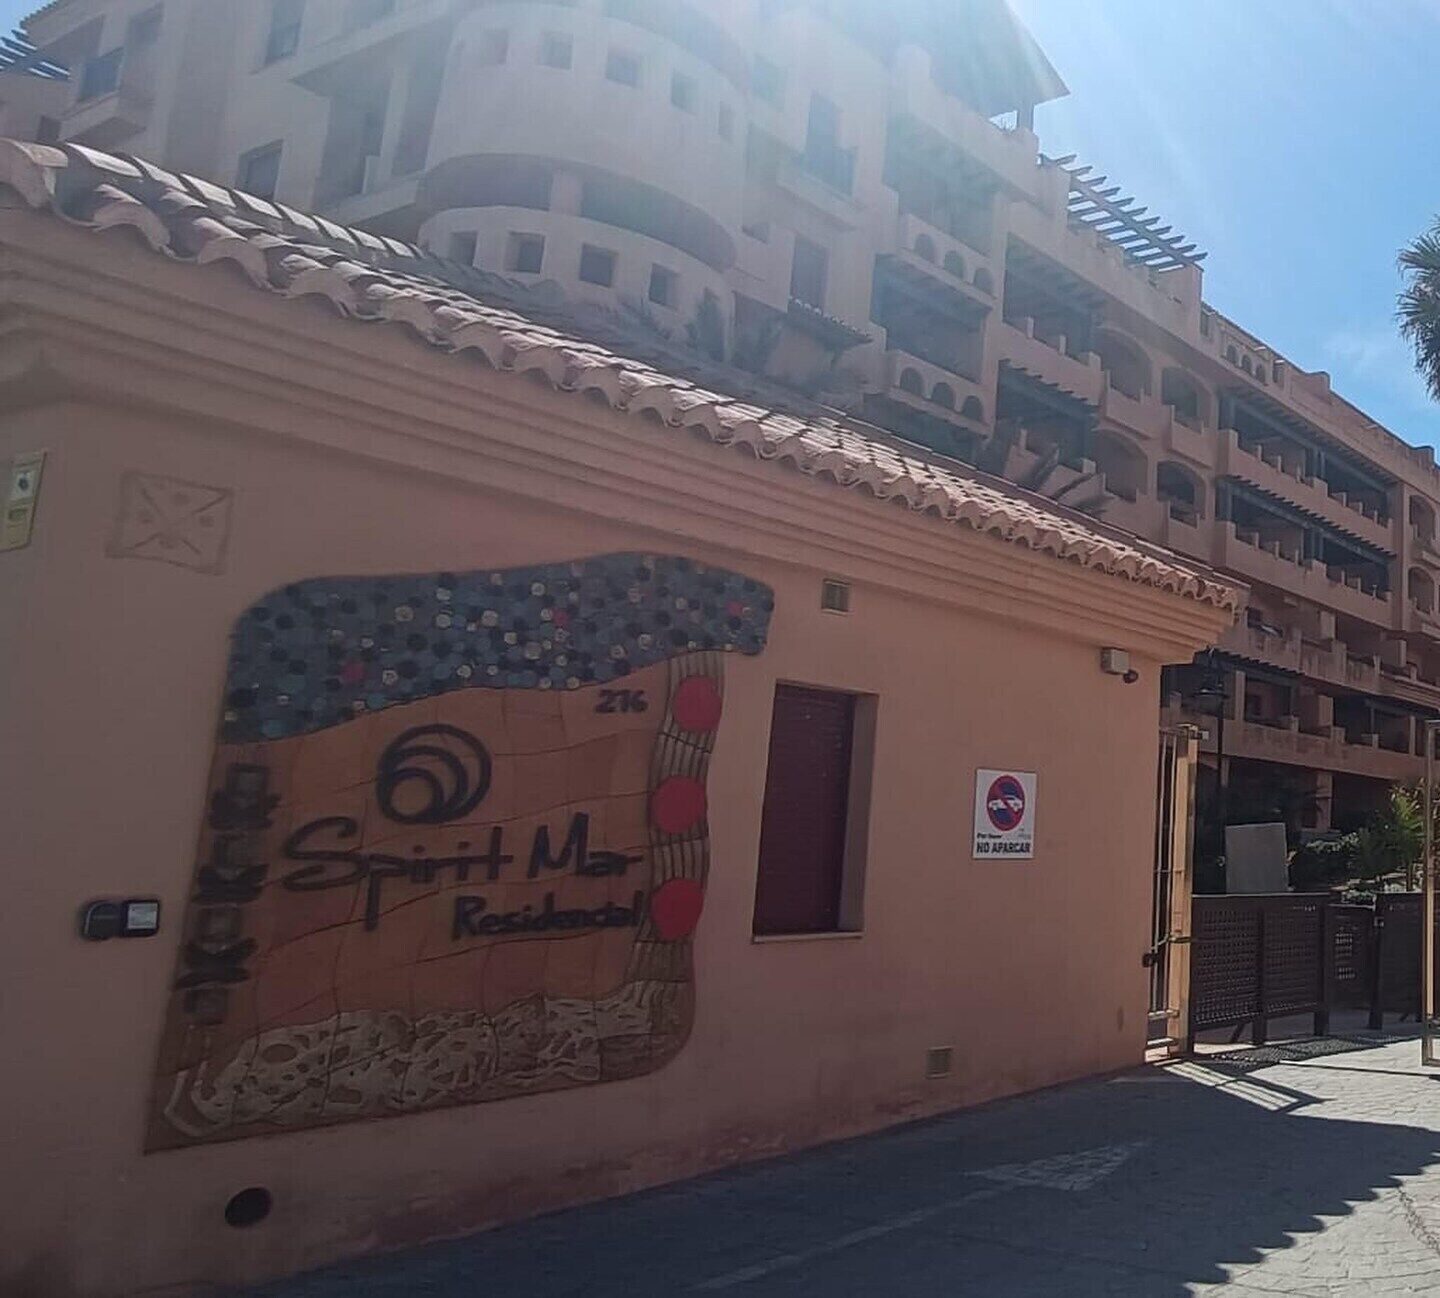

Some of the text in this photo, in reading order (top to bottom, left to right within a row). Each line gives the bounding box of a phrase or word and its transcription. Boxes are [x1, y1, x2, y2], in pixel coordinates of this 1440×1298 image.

[281, 811, 643, 932] Spirit Mar
[976, 842, 1030, 854] NO APARCAR
[453, 890, 644, 941] Residencial
